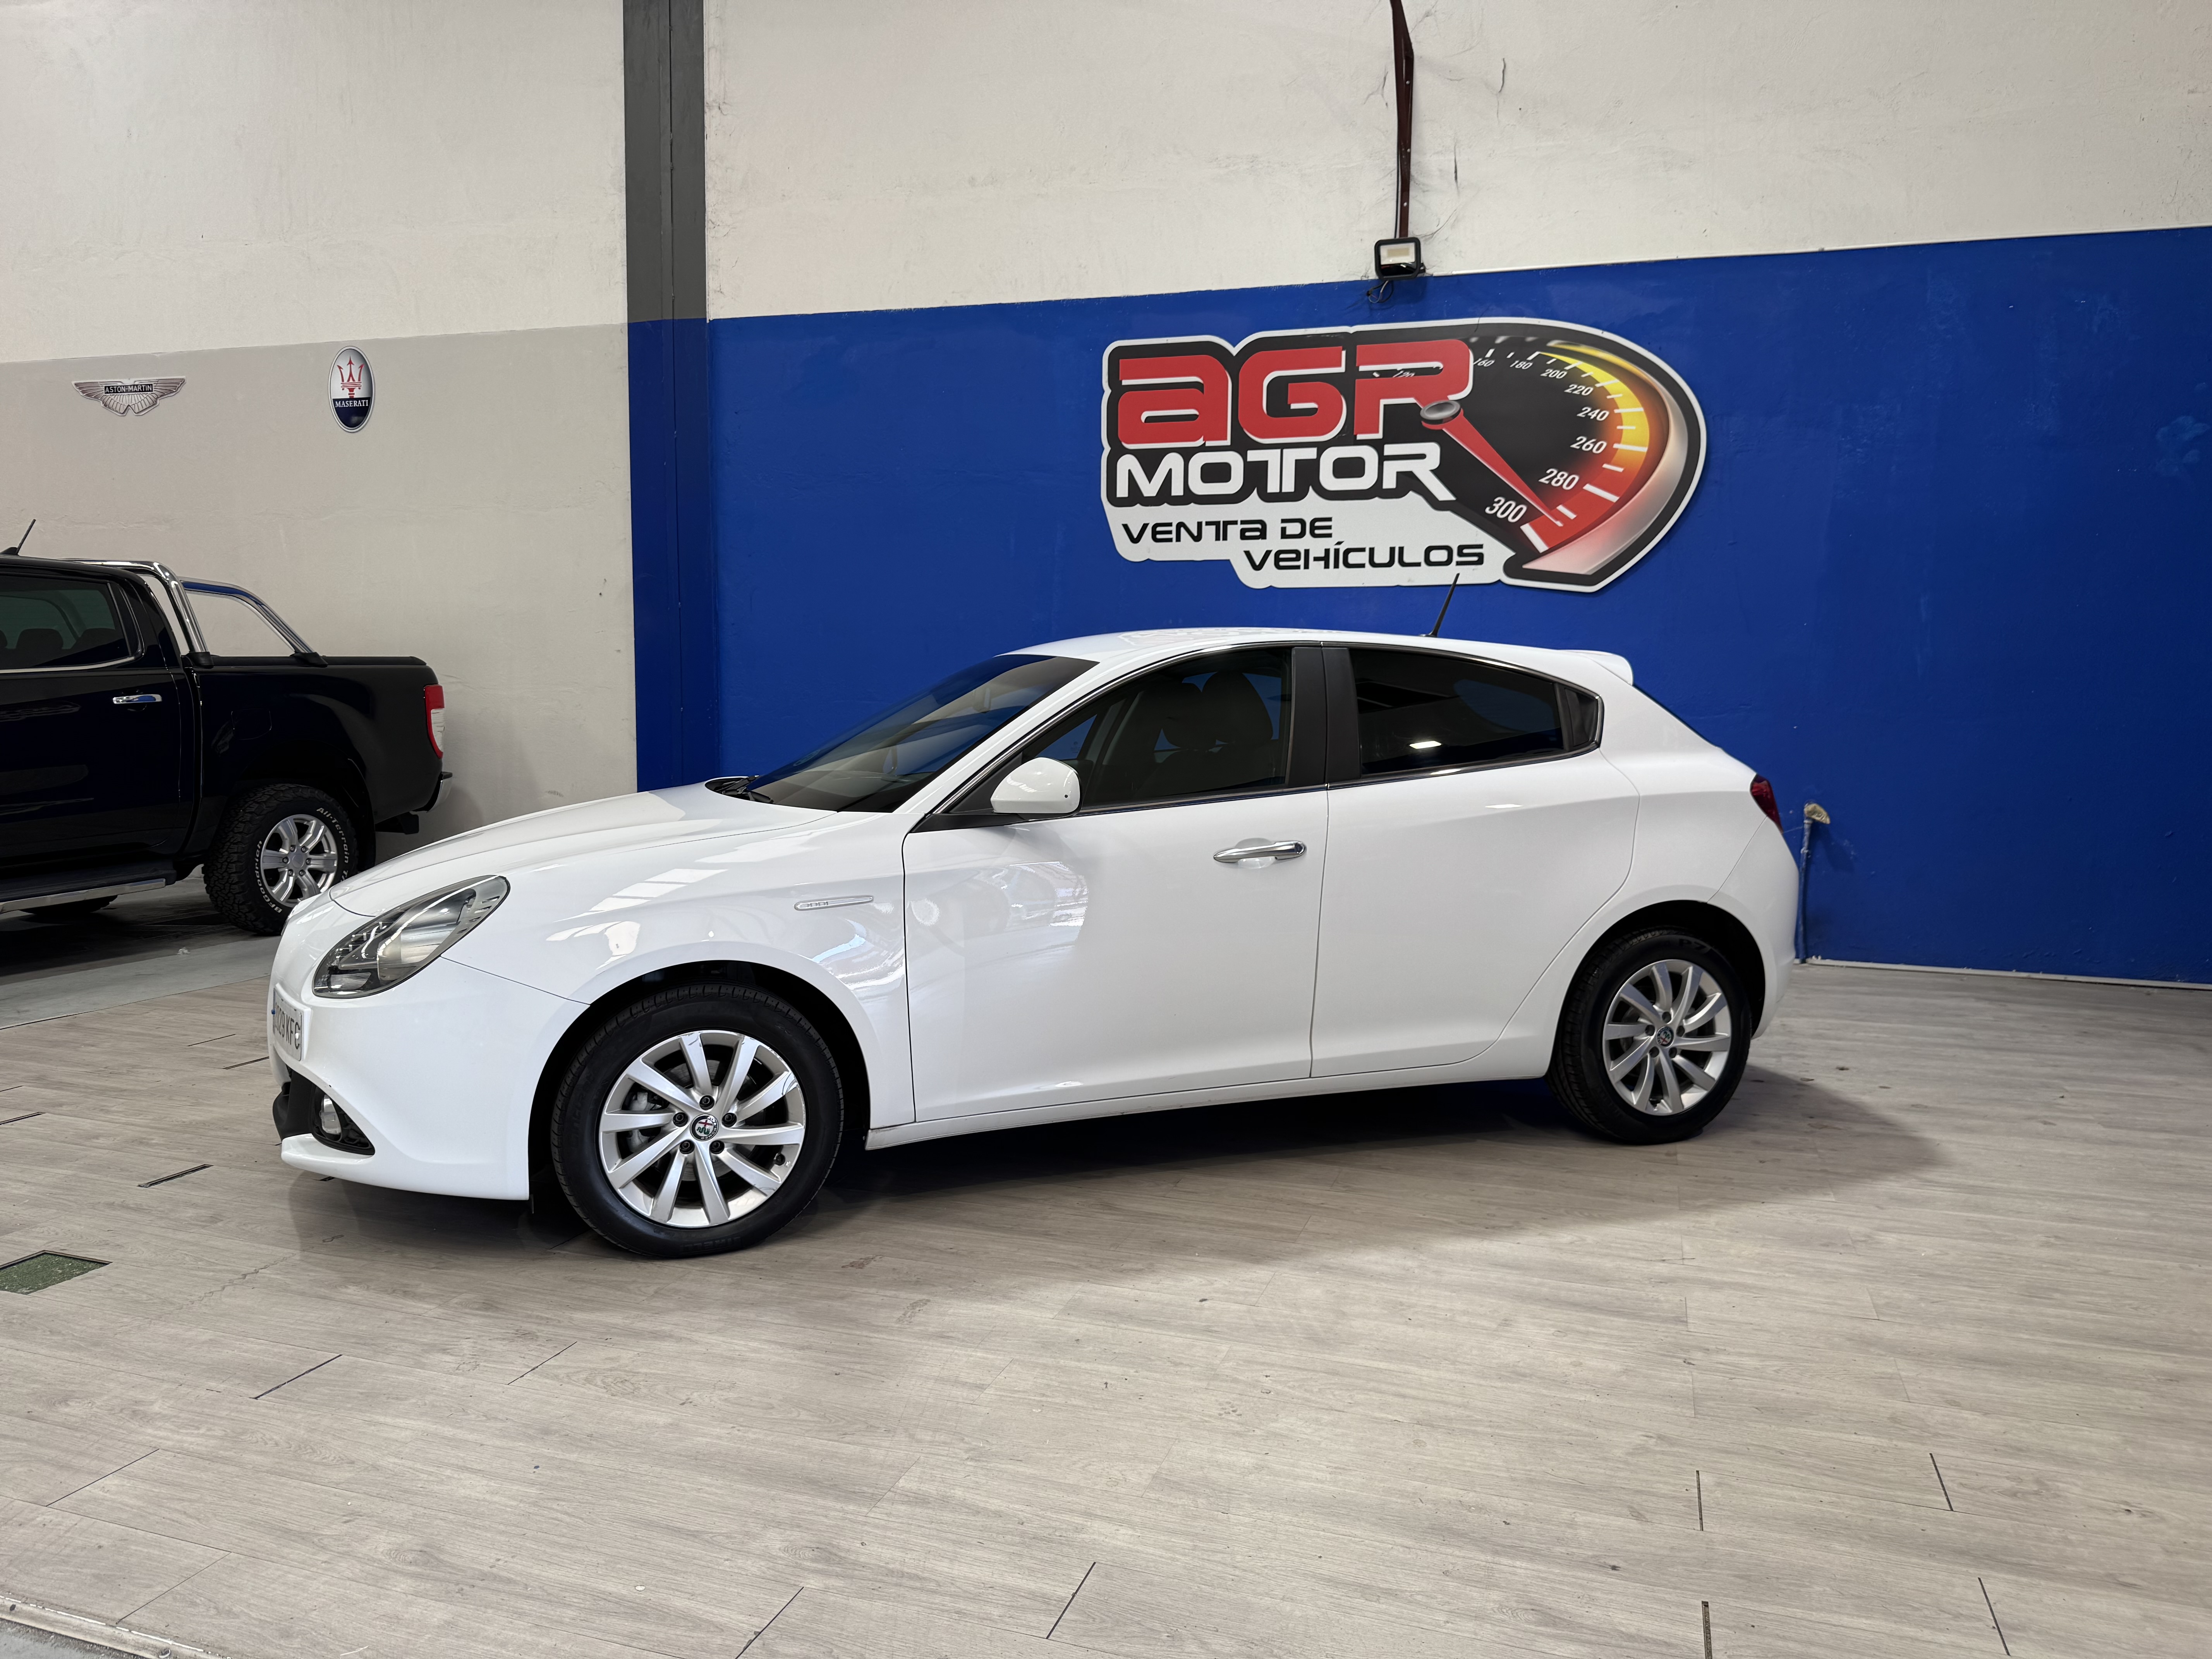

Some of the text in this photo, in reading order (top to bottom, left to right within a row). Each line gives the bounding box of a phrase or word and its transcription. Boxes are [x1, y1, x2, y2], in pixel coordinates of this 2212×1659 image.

[1473, 358, 1495, 367] 160
[1510, 360, 1533, 369] 180
[1540, 369, 1567, 379] 200
[105, 385, 152, 393] ASTON-MARTIN
[1564, 384, 1594, 396] 220
[335, 400, 369, 408] MASERATI
[1577, 406, 1610, 421] 240
[1570, 436, 1607, 454] 260
[1116, 442, 1457, 501] MOTOR
[1538, 468, 1580, 490] 280
[1485, 496, 1527, 522] 300
[1280, 517, 1333, 539] DE
[316, 807, 349, 863] All-Terrain
[254, 841, 282, 913] BFGoodrich
[286, 1015, 300, 1049] KFC
